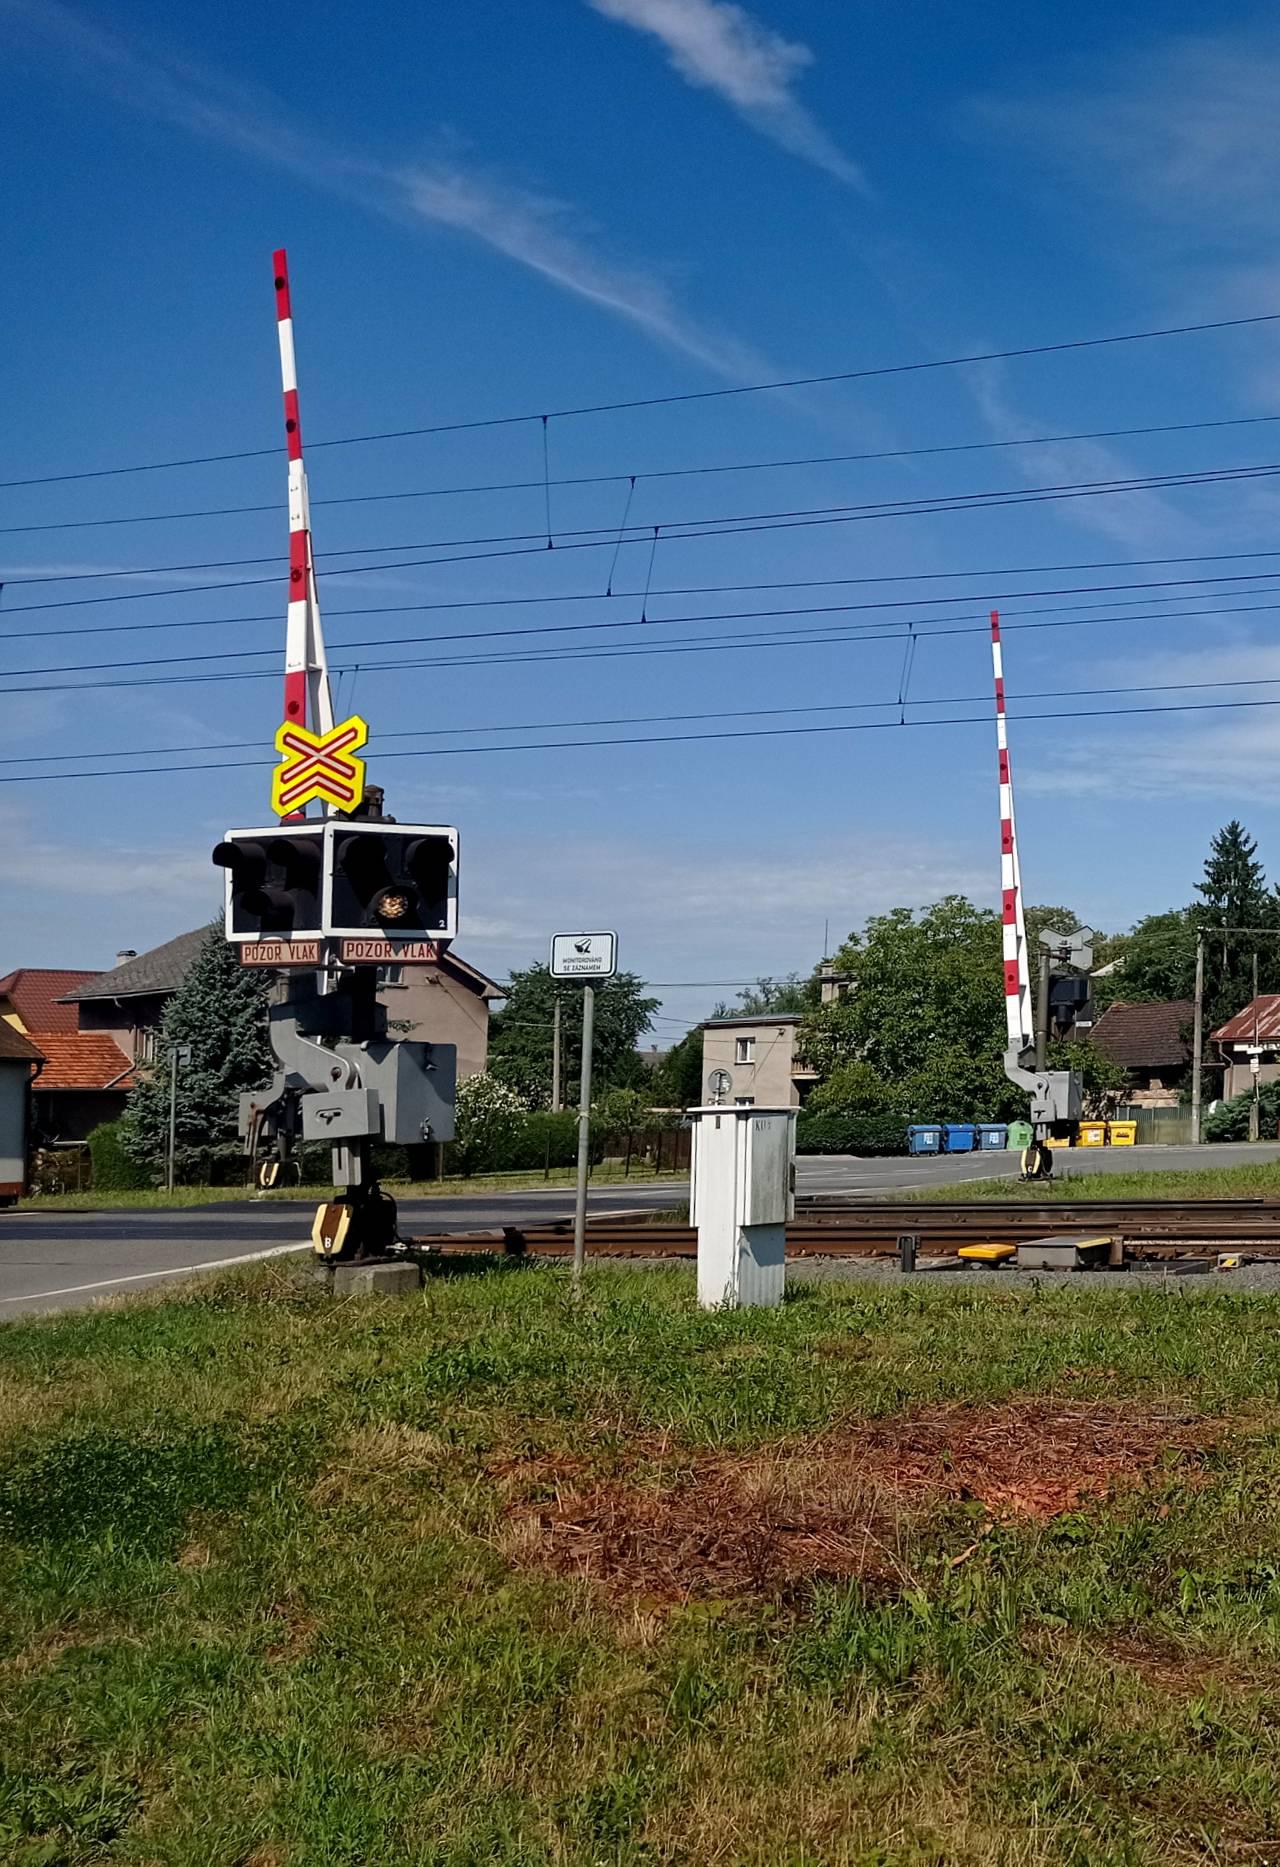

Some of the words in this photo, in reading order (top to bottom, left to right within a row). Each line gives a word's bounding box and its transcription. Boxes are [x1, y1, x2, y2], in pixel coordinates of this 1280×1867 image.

[438, 919, 446, 928] 2
[244, 945, 282, 961] POZOR
[289, 944, 315, 960] VLAK
[346, 941, 391, 958] POZOR
[402, 942, 434, 958] VLAK
[324, 1237, 332, 1248] B
